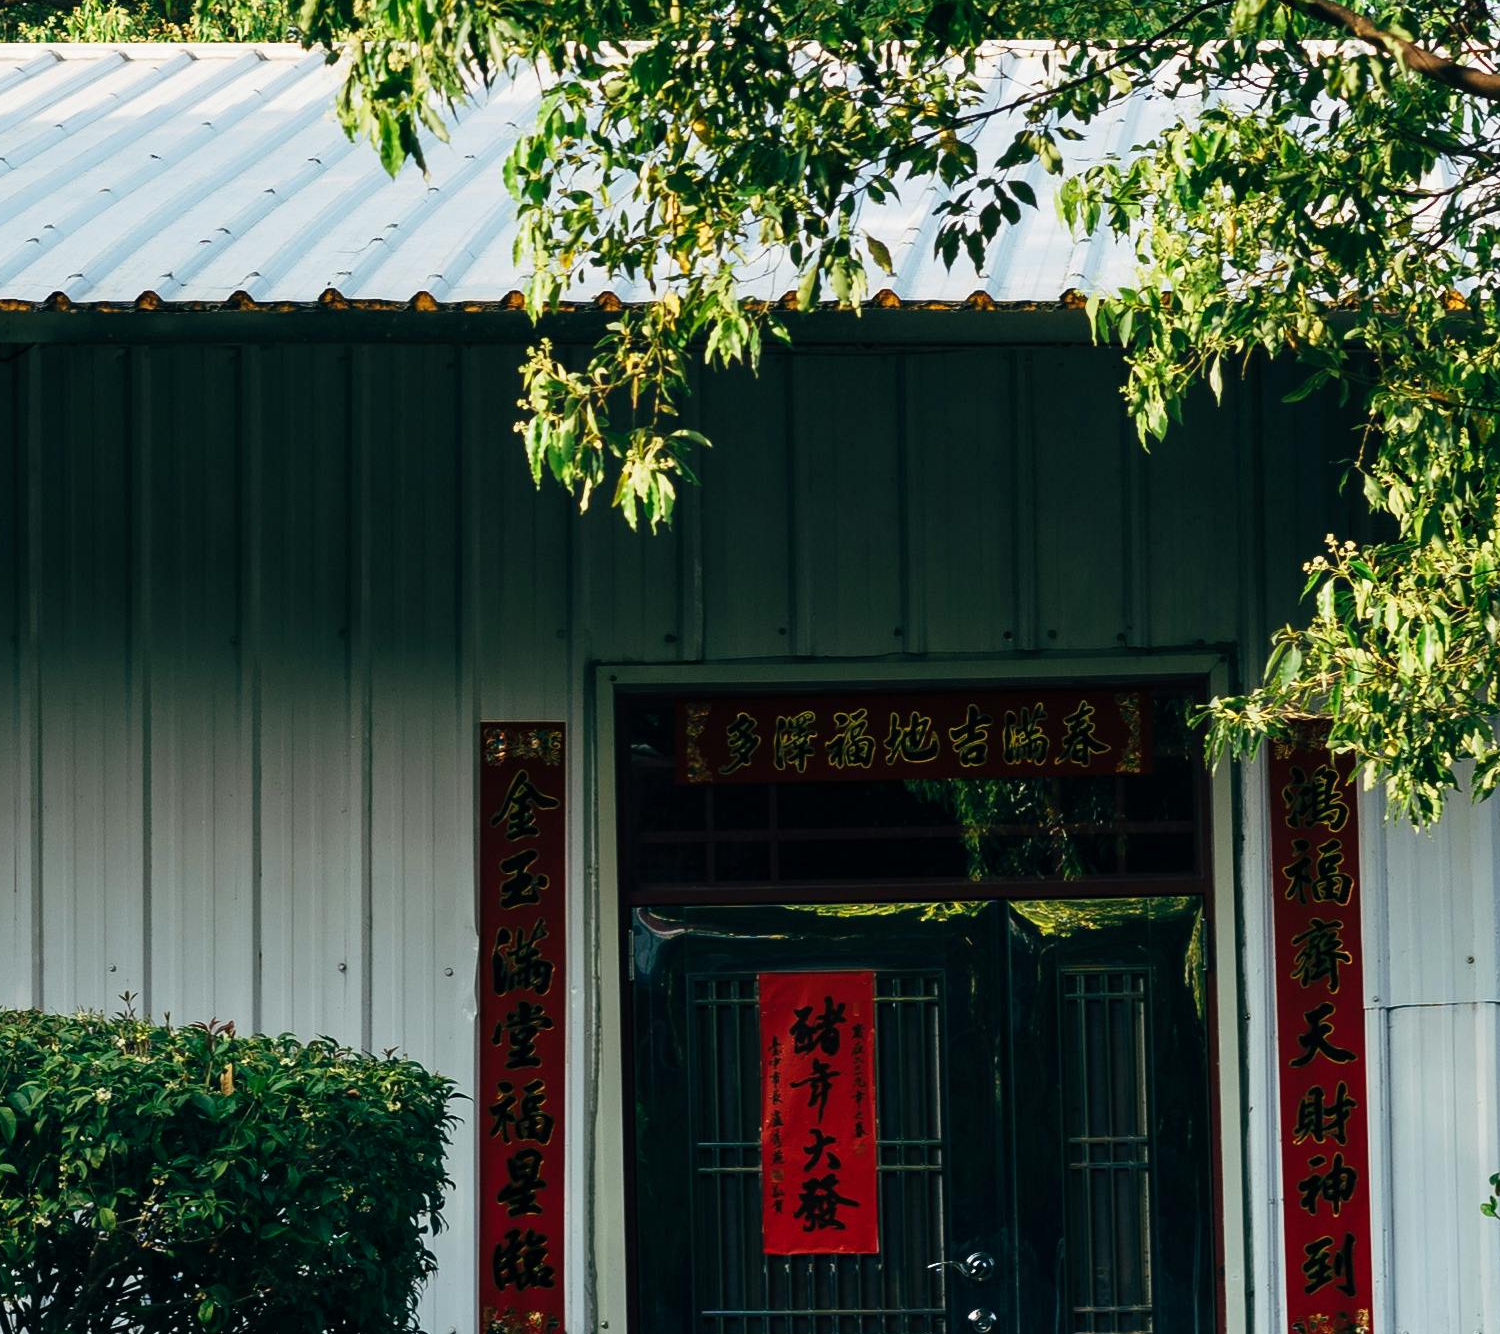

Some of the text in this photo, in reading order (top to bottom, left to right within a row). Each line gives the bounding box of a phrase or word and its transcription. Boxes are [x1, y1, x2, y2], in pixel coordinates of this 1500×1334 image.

[488, 768, 561, 1296] 金玉滿堂福星臨
[790, 995, 861, 1234] 豬年大發
